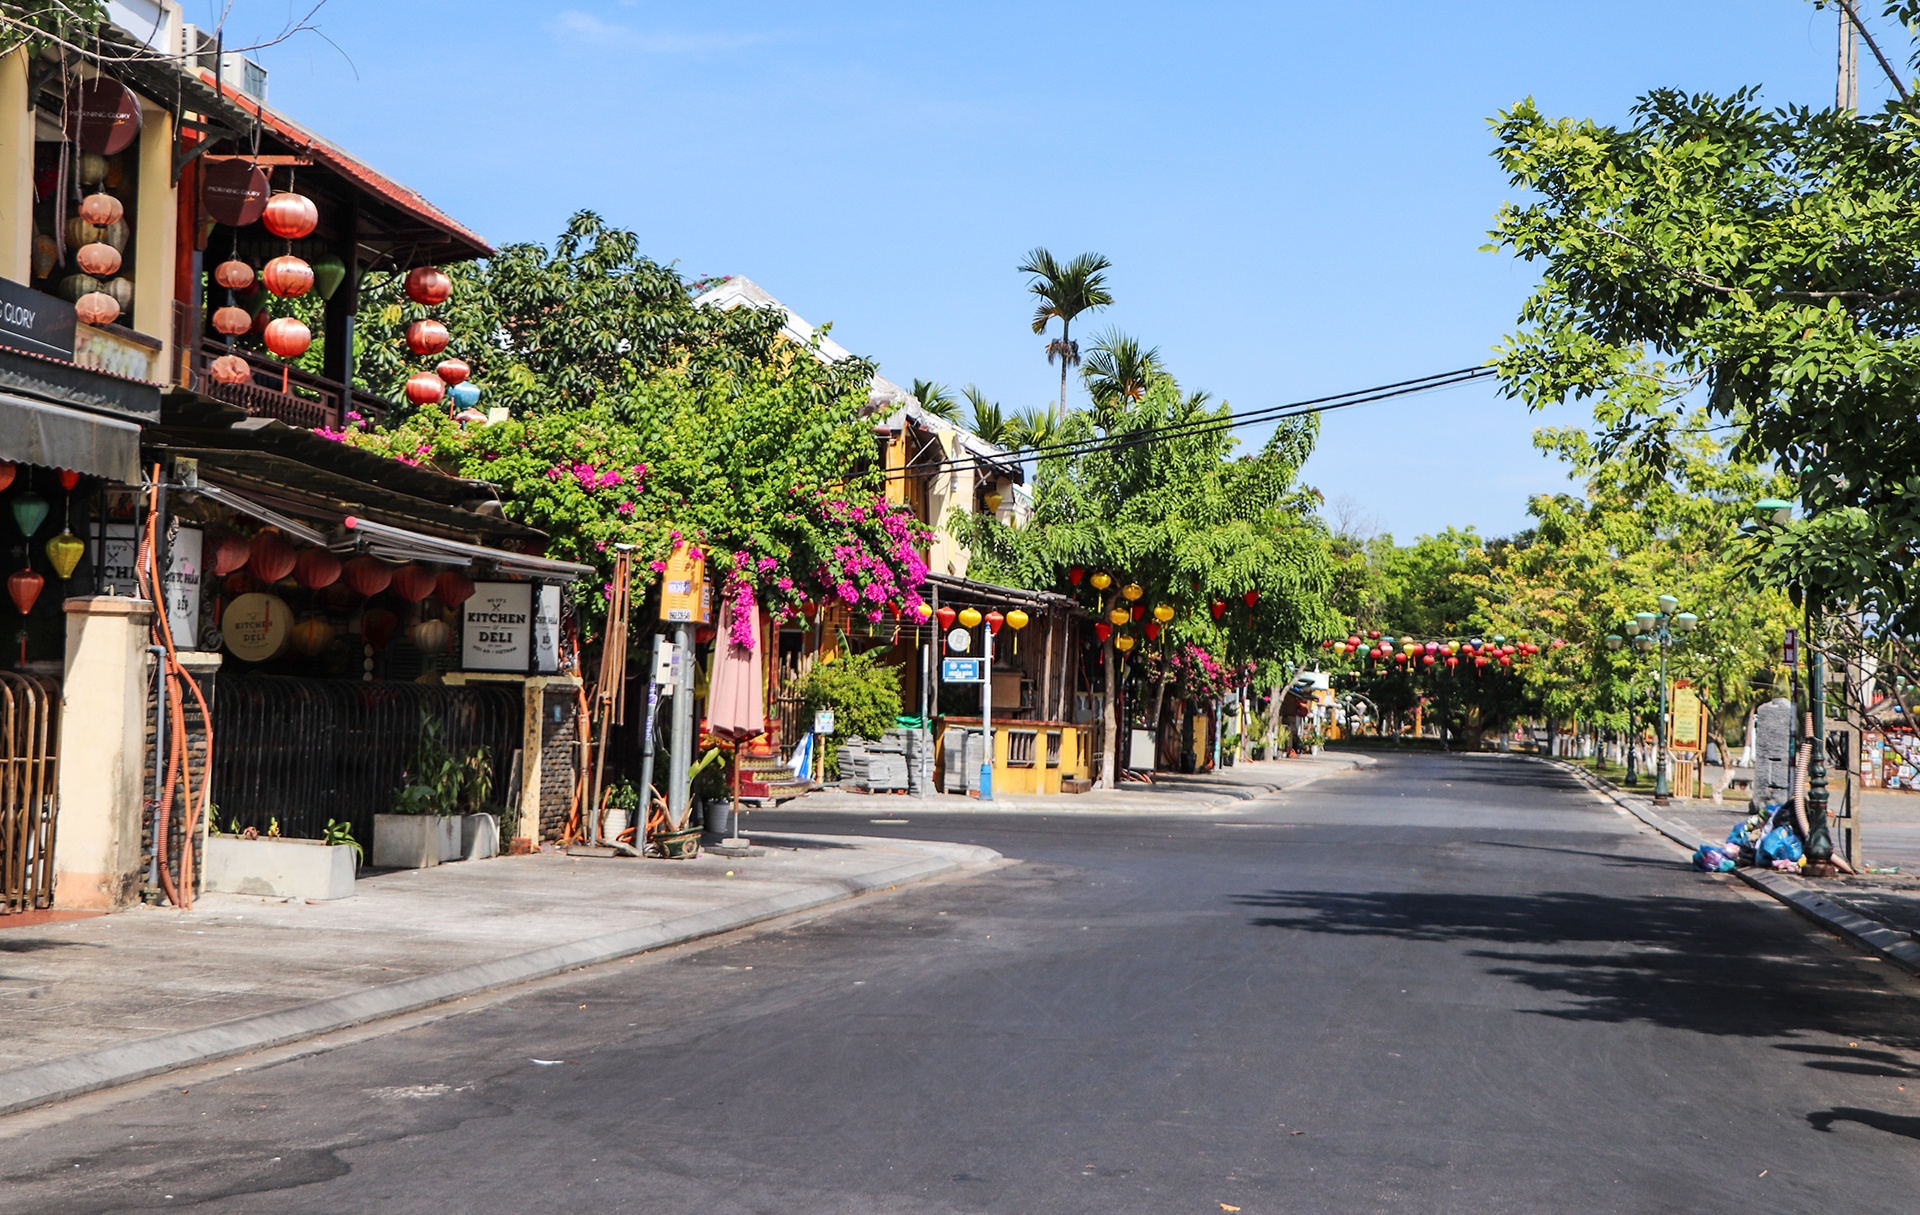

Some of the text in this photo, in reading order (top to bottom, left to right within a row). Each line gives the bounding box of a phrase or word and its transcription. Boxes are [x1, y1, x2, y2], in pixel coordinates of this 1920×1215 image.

[4, 302, 36, 329] GLORY
[467, 613, 526, 624] KITCHEN
[243, 633, 266, 642] DELI
[479, 631, 513, 643] DELI
